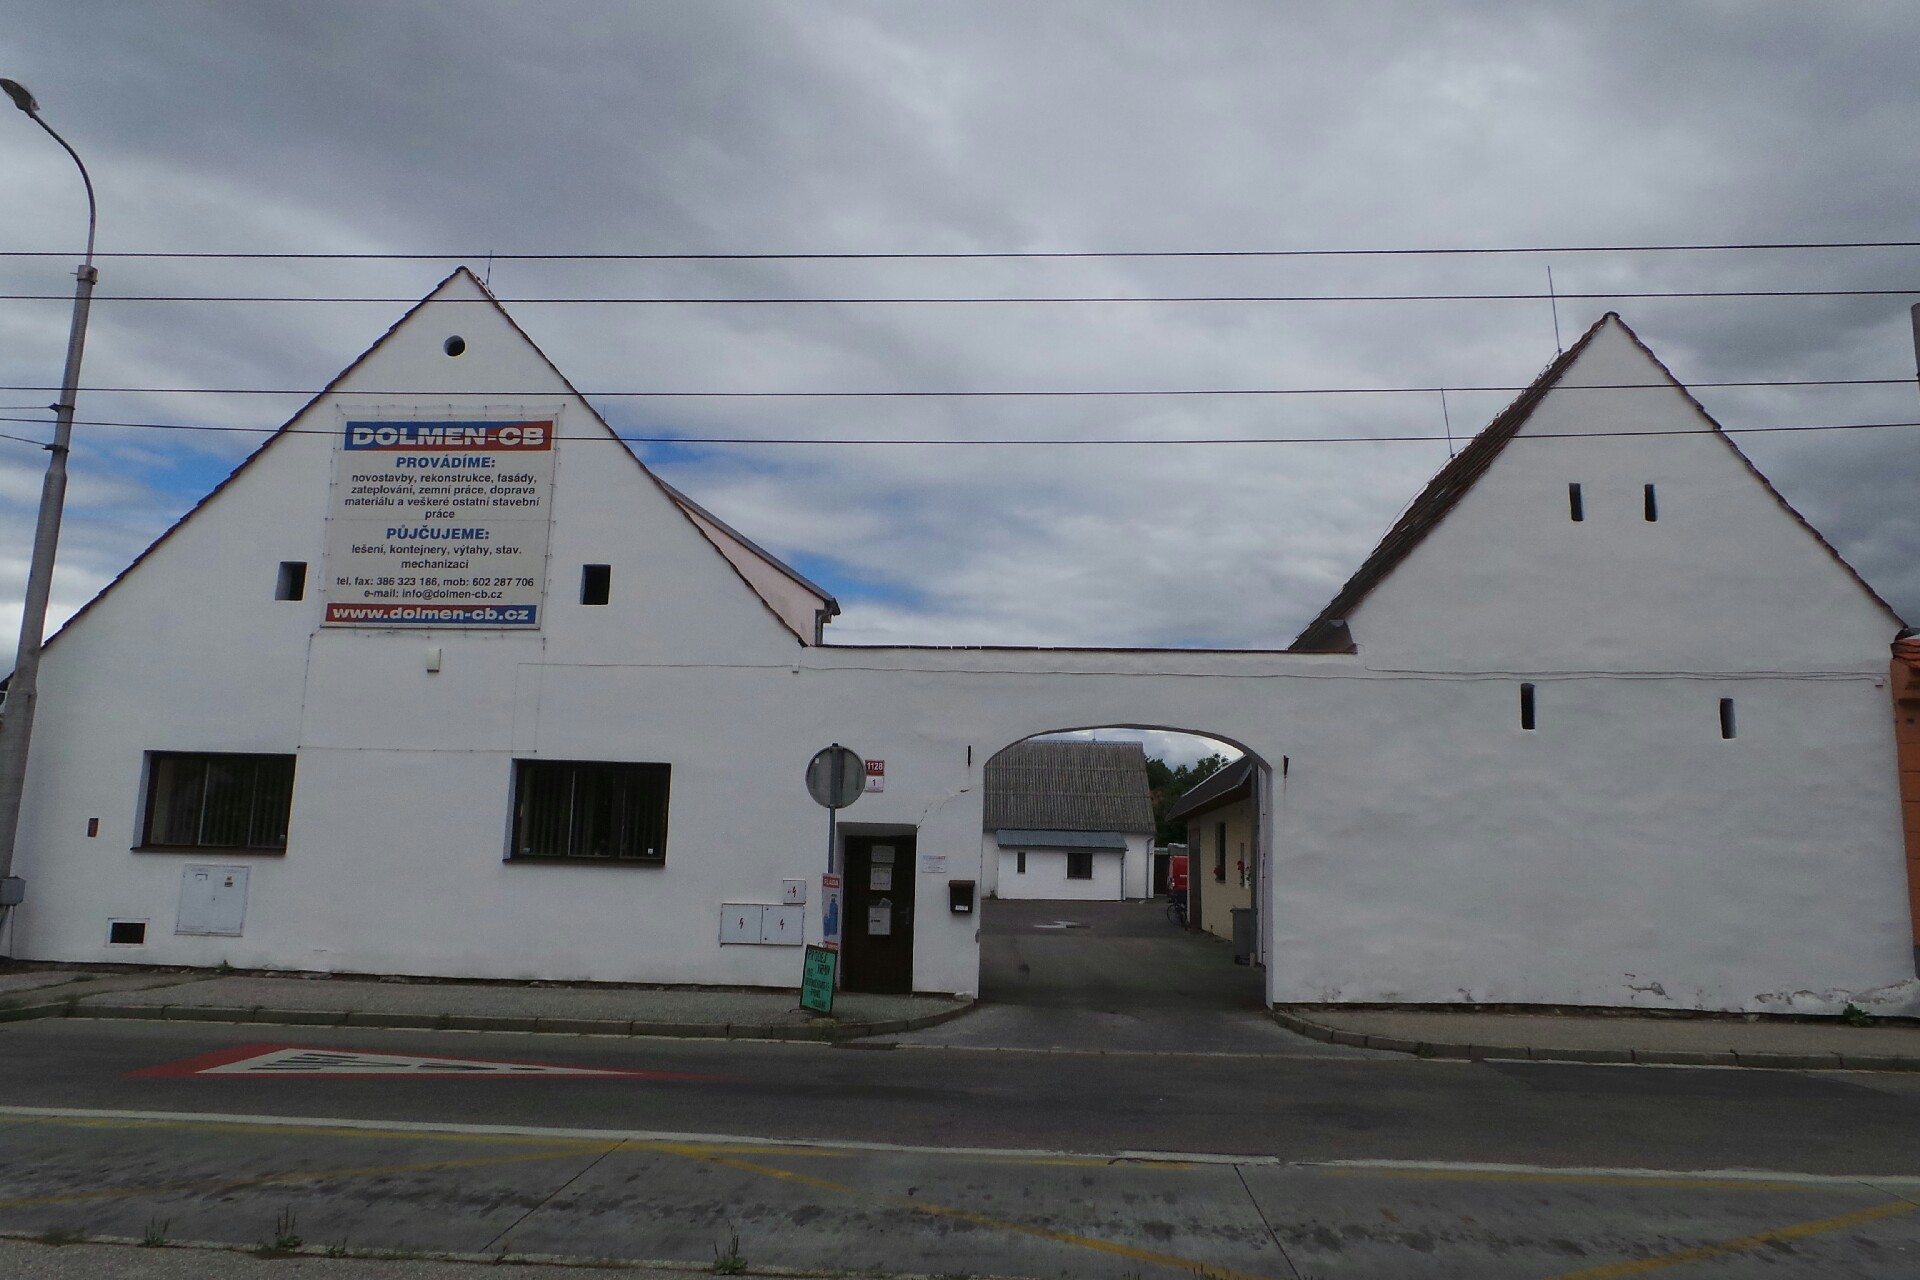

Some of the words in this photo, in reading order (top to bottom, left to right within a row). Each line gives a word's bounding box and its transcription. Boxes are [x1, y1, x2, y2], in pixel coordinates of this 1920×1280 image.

[352, 427, 544, 446] DOLMEN-CB
[396, 454, 496, 468] PROVÁDÍME:
[352, 473, 417, 485] novostavby,
[420, 473, 494, 484] rekonstrukce,
[497, 473, 537, 485] fasády,
[351, 485, 415, 496] zateplování,
[418, 485, 451, 495] zemní
[453, 485, 487, 496] práce,
[490, 485, 536, 496] doprava
[344, 497, 395, 506] materiálu
[407, 497, 449, 506] veškeré
[452, 497, 490, 506] ostatní
[492, 497, 540, 507] stavební
[424, 510, 455, 520] práce
[386, 524, 490, 540] PŮJČUJEME:
[351, 544, 387, 556] lešení,
[389, 544, 450, 556] kontejnery,
[453, 544, 492, 557] výtahy,
[495, 545, 522, 555] stav.
[401, 559, 469, 569] mechanizaci
[354, 577, 374, 586] fax:
[376, 577, 395, 586] 386
[397, 577, 416, 586] 323
[420, 578, 440, 588] 186,
[443, 577, 470, 587] mob:
[472, 578, 491, 587] 602
[493, 578, 513, 587] 287
[515, 578, 534, 587] 706
[364, 589, 399, 598] e-mail:
[402, 589, 503, 600] info@dolmen-cb.cz
[332, 607, 529, 620] www.dolmen-cb.cz
[867, 762, 883, 771] 1128
[872, 779, 876, 787] 1
